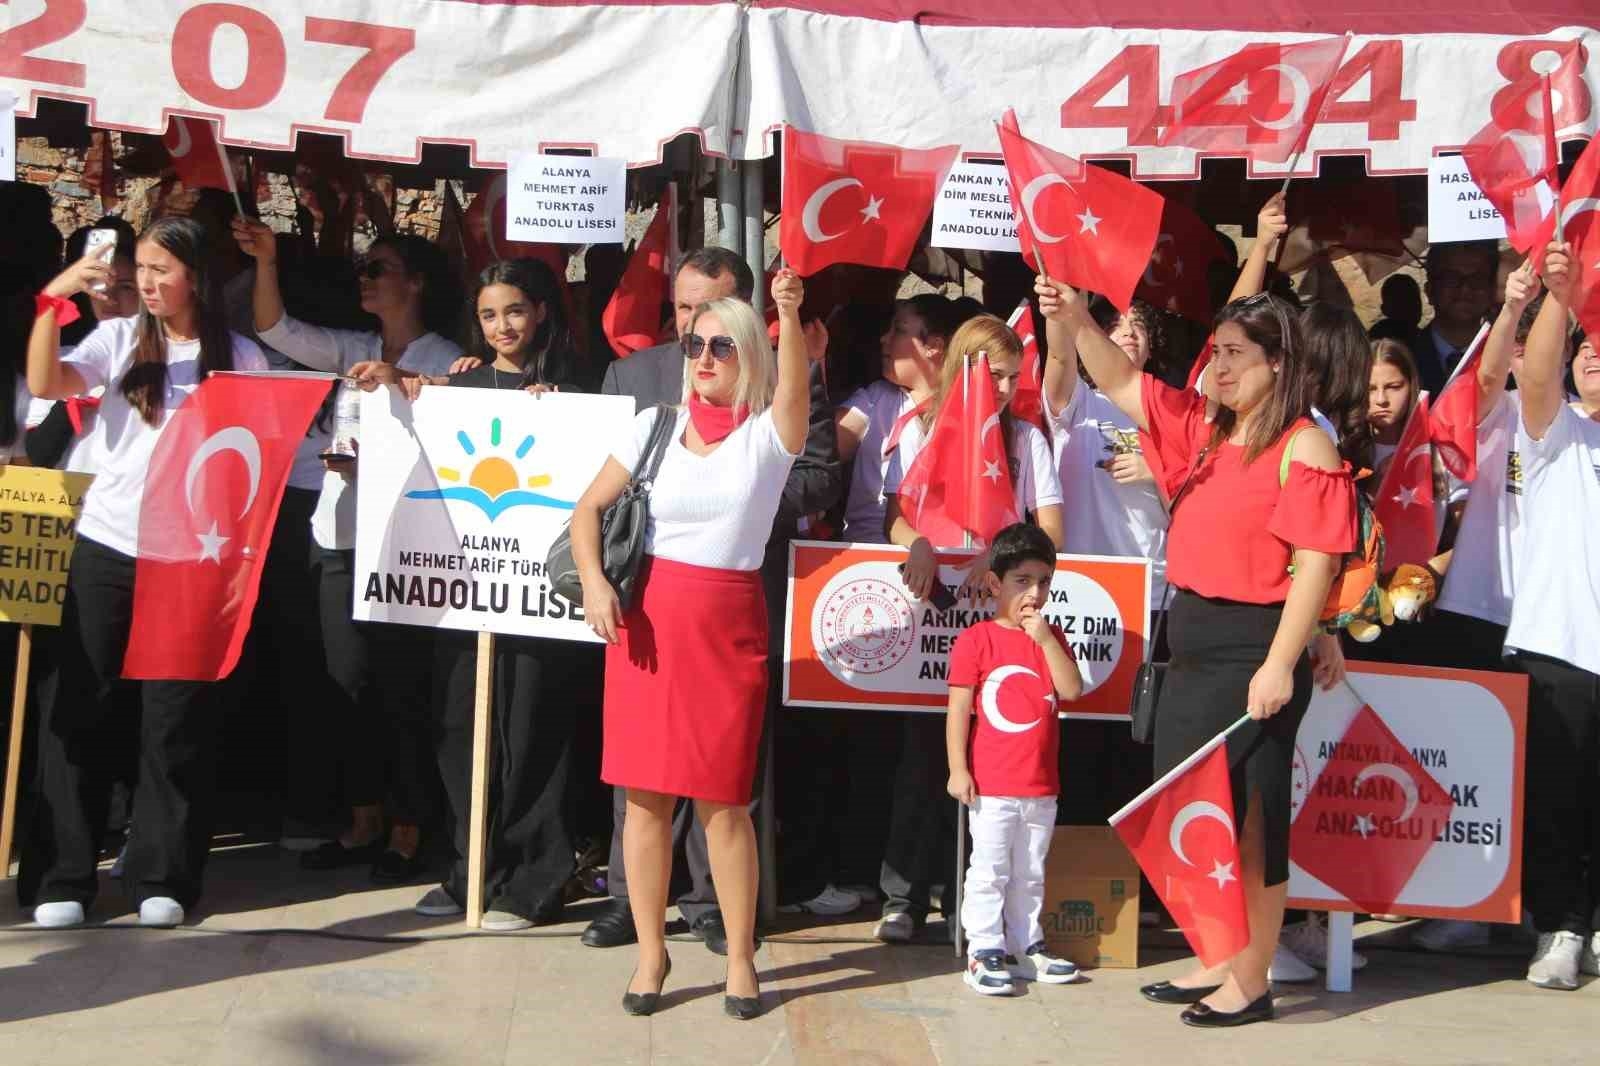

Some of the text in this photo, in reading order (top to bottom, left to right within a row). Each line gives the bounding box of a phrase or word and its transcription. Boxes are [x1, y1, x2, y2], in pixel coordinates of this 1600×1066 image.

[1061, 39, 1417, 147] 444
[542, 167, 591, 178] ALANYA
[524, 183, 608, 195] MEHMET ARİF
[944, 190, 1010, 204] DİM MESLE
[970, 208, 1015, 221] TEKNİK
[515, 216, 616, 229] ANADOLU LİSESİ
[940, 223, 998, 236] ANADOLU
[461, 534, 520, 552] ALANYA
[400, 550, 466, 571] MEHMET
[471, 557, 506, 573] ARİF
[364, 573, 509, 613] ANADOLU
